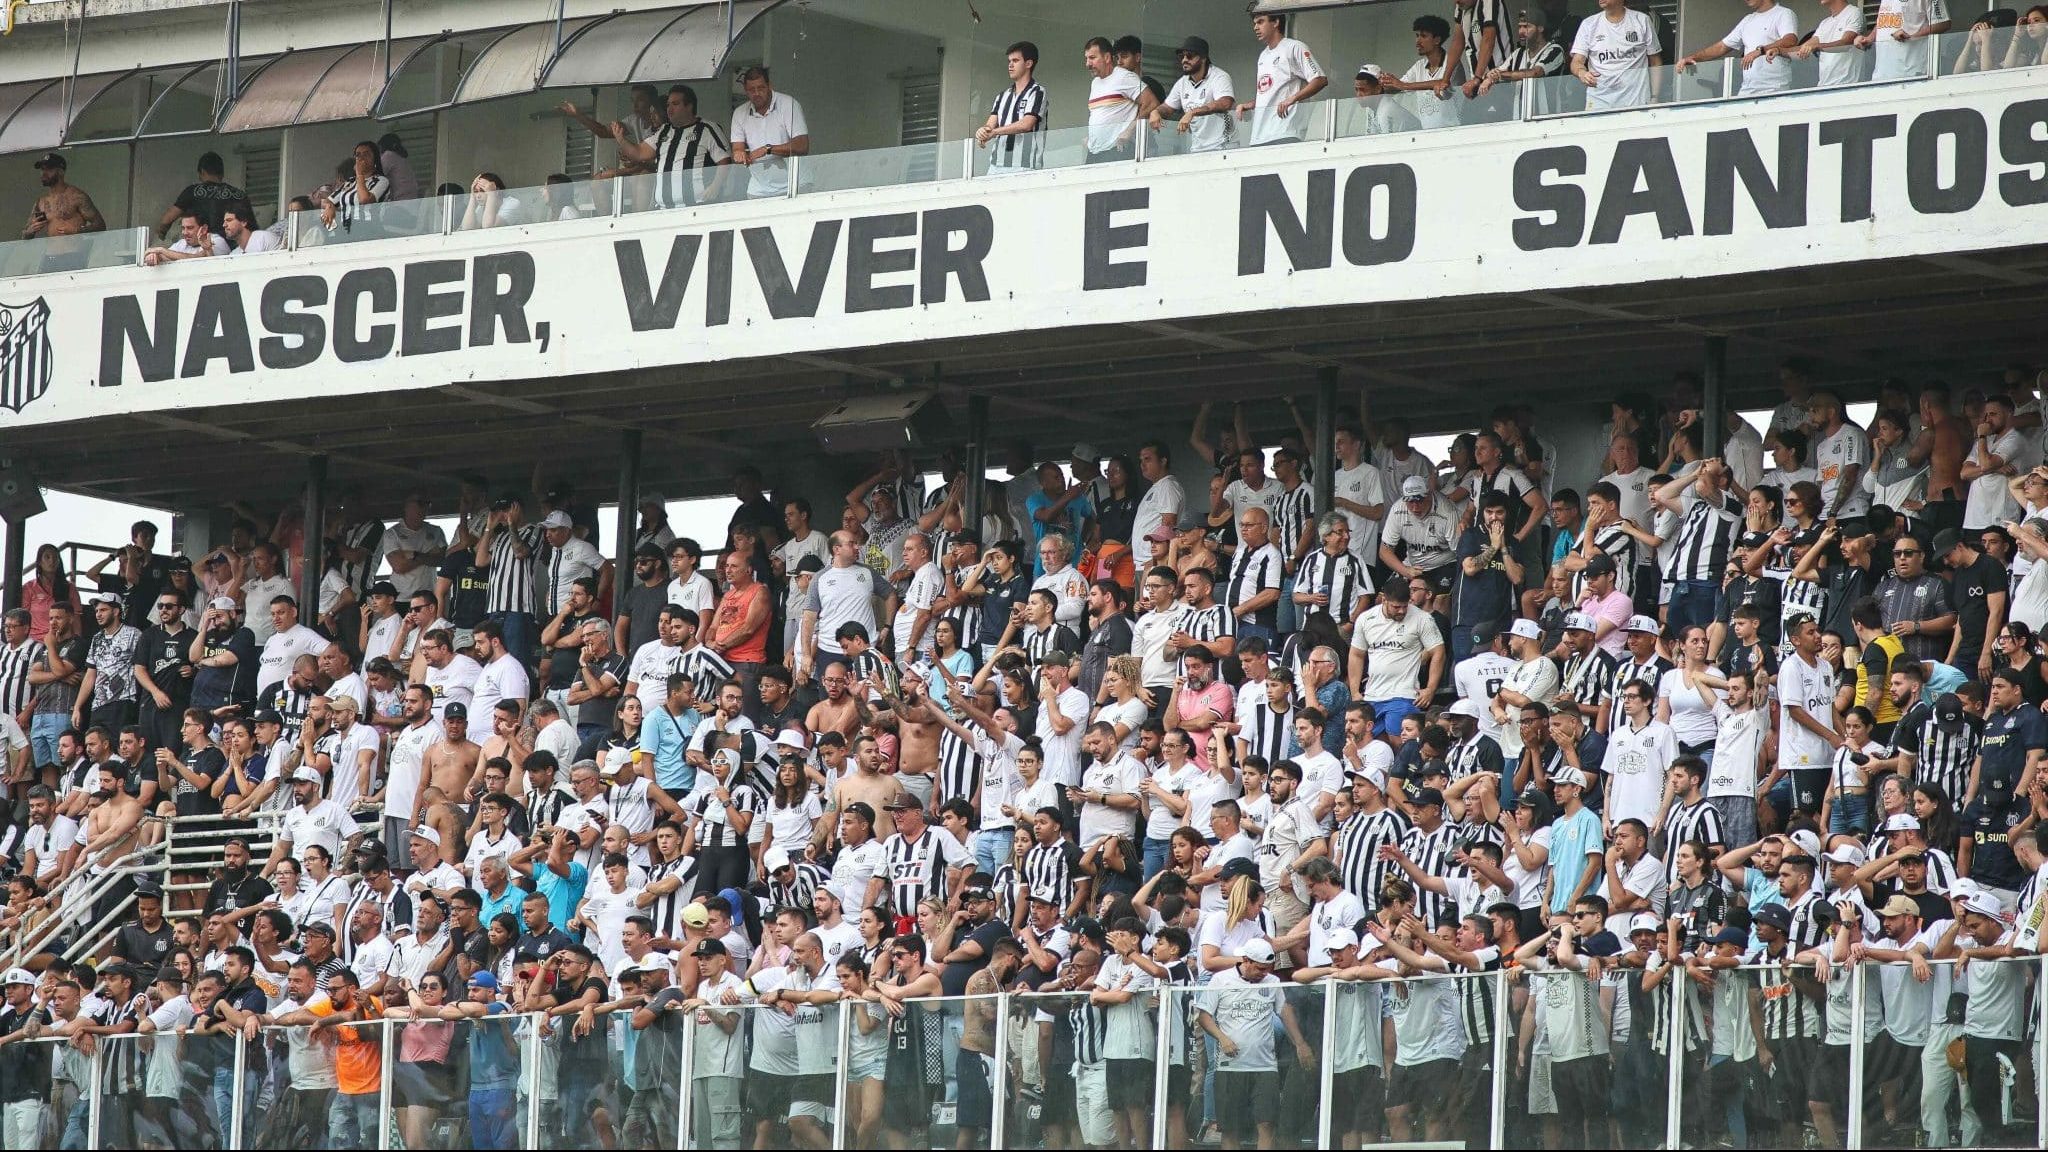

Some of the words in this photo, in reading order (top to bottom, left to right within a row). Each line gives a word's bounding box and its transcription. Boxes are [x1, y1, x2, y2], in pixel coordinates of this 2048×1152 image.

[99, 251, 551, 387] NASCER,
[614, 205, 993, 331] VIVER
[1083, 188, 1149, 291] E
[1238, 163, 1417, 276] NO
[1512, 97, 2048, 251] SANTOS
